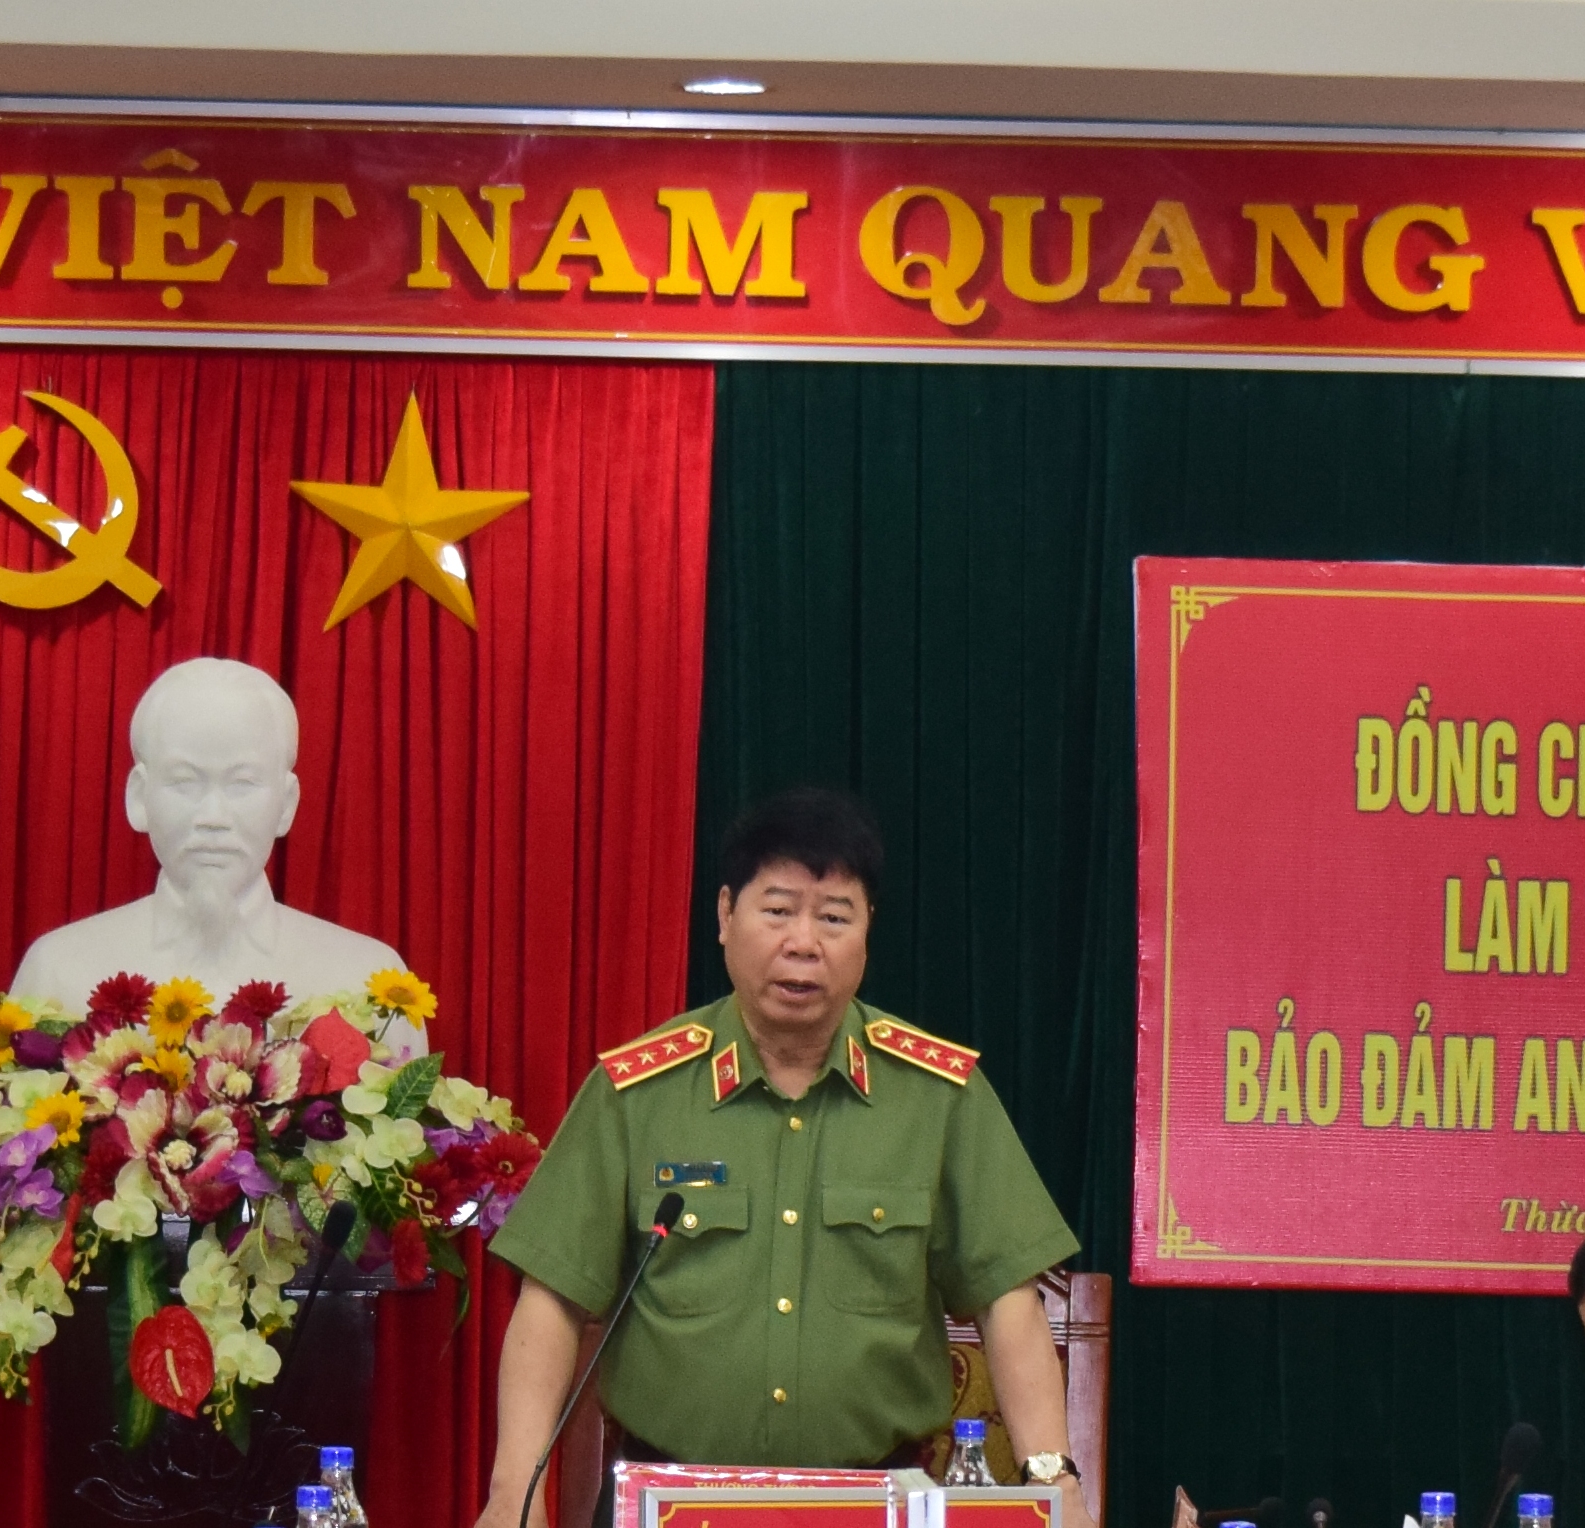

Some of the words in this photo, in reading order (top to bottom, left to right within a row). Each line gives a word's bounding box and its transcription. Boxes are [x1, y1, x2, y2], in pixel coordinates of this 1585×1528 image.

[407, 185, 809, 299] NAM
[858, 186, 1485, 326] QUANG
[1355, 686, 1518, 816] ĐỒNG
[1444, 858, 1570, 975] LÀM
[1225, 997, 1343, 1126] BẢO
[1361, 1002, 1496, 1131] ĐẢM
